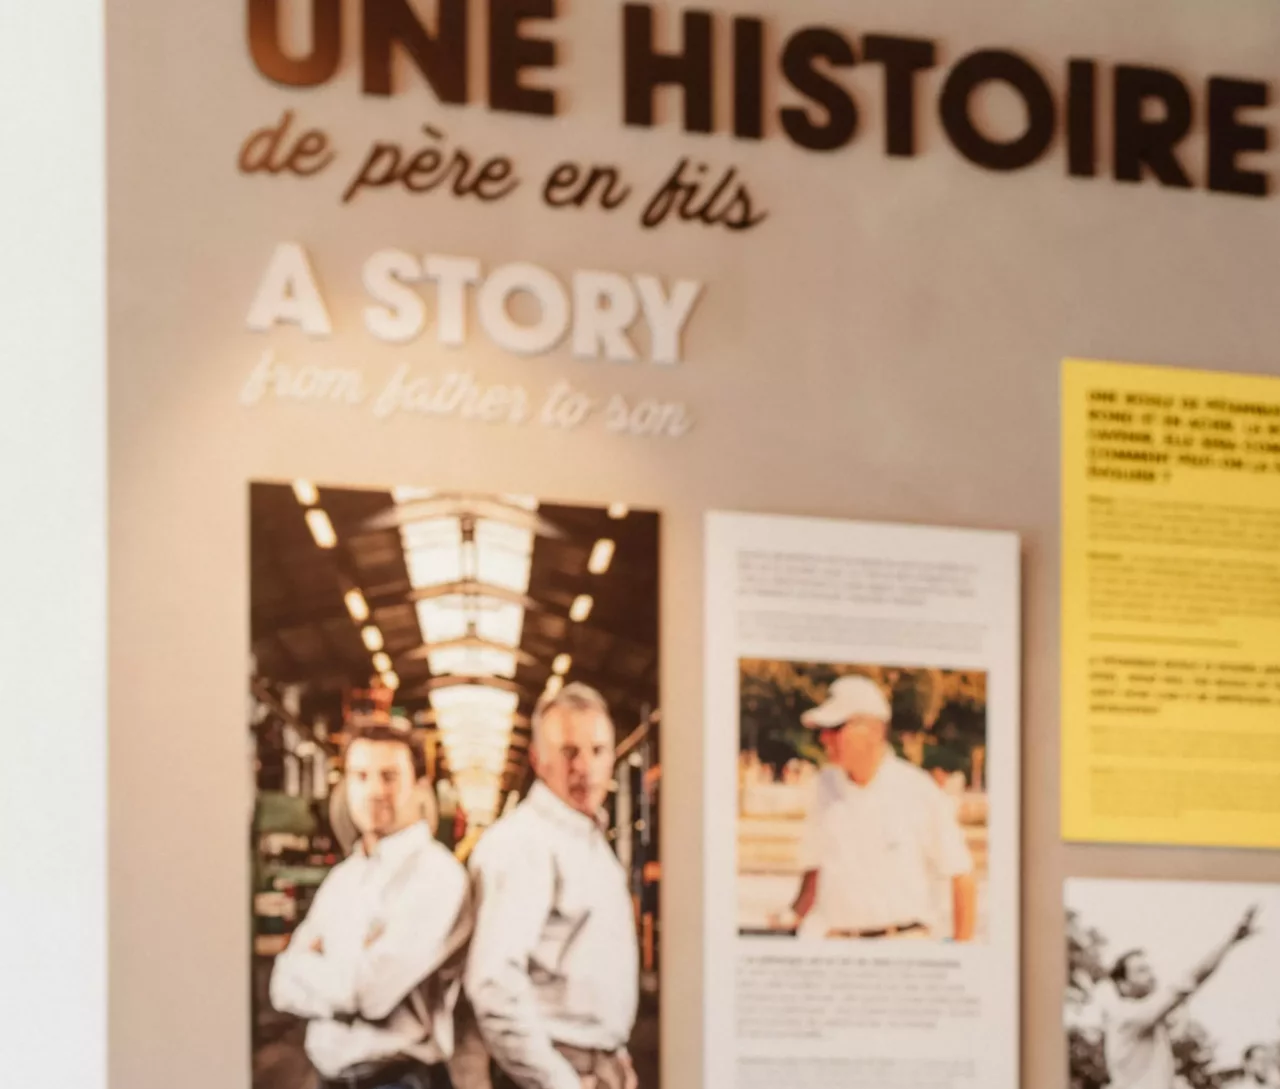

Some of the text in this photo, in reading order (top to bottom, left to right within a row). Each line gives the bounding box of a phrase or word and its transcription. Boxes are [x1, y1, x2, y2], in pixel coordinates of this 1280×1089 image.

[246, 0, 1269, 197] UNE HISTOIRE
[237, 109, 769, 231] de père en fils
[246, 243, 704, 364] A STORY
[240, 348, 693, 437] from father to son
